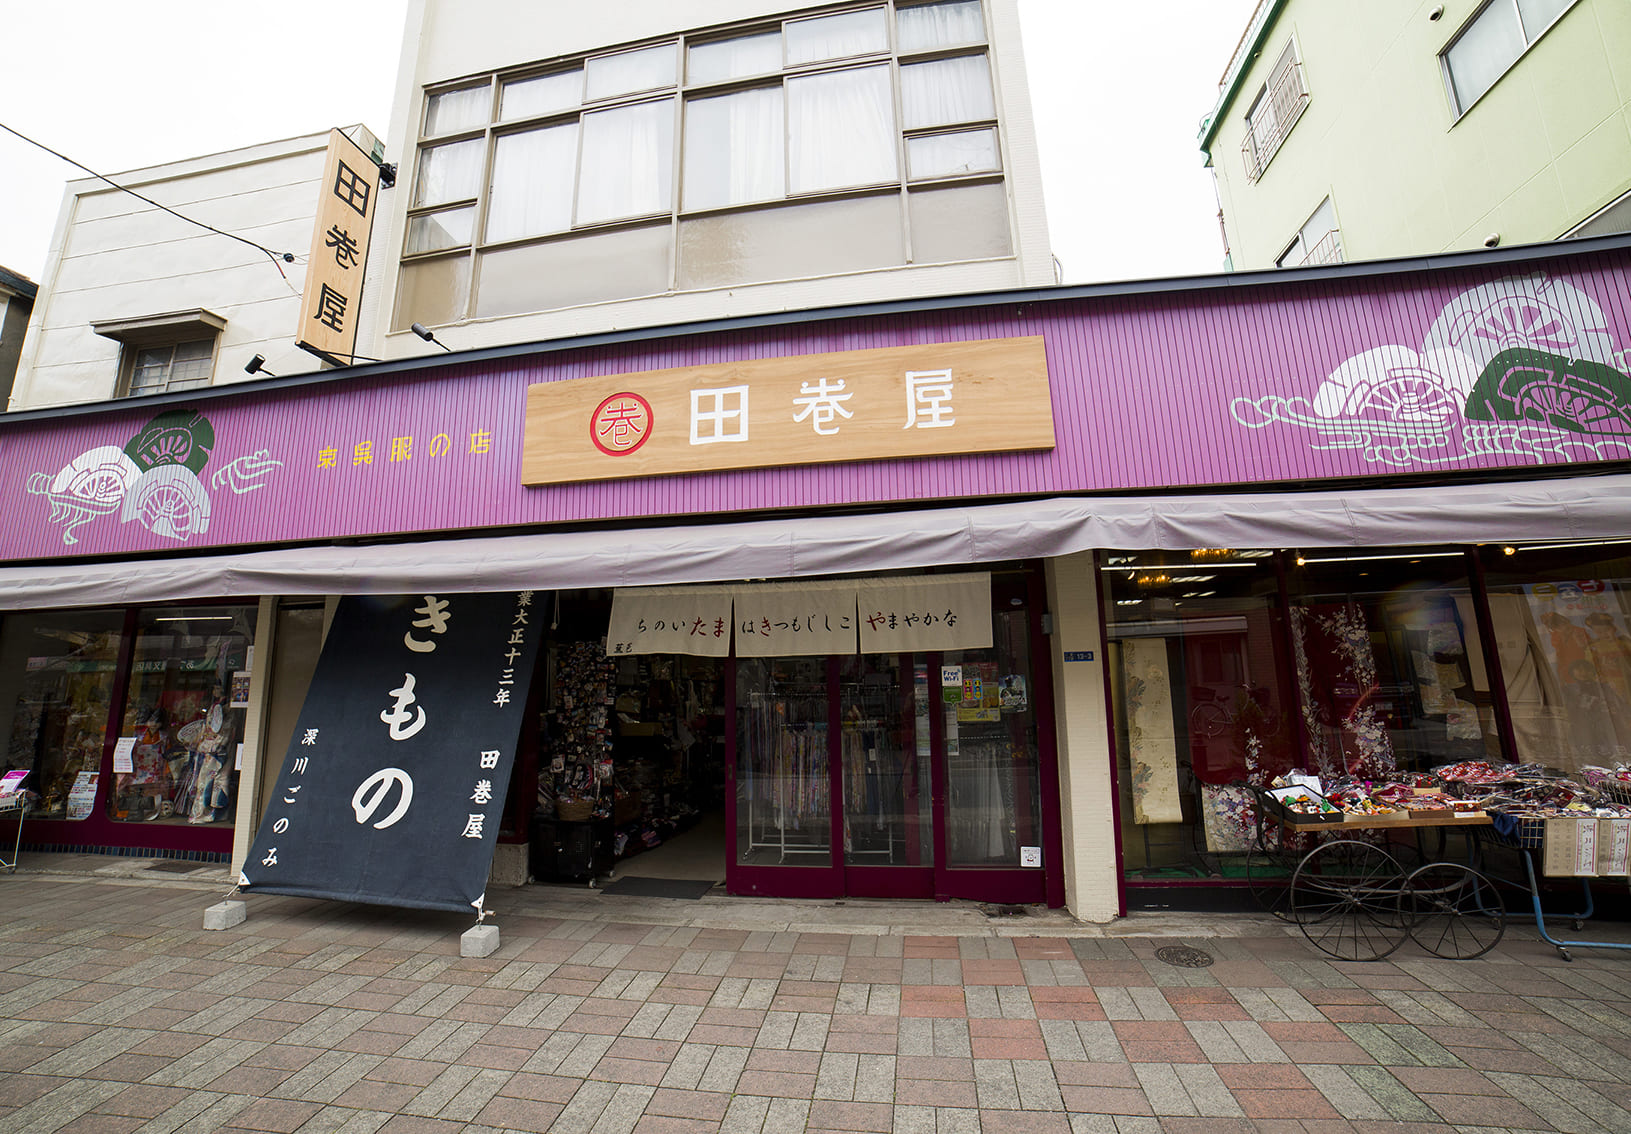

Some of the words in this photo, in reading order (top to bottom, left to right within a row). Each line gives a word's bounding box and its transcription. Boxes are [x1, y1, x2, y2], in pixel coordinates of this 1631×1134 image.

[313, 158, 371, 334] 田巻屋
[689, 368, 956, 446] 田巻屋
[351, 595, 452, 830] きもの
[261, 727, 320, 868] 深川ごのみ
[460, 749, 501, 840] 田巻屋
